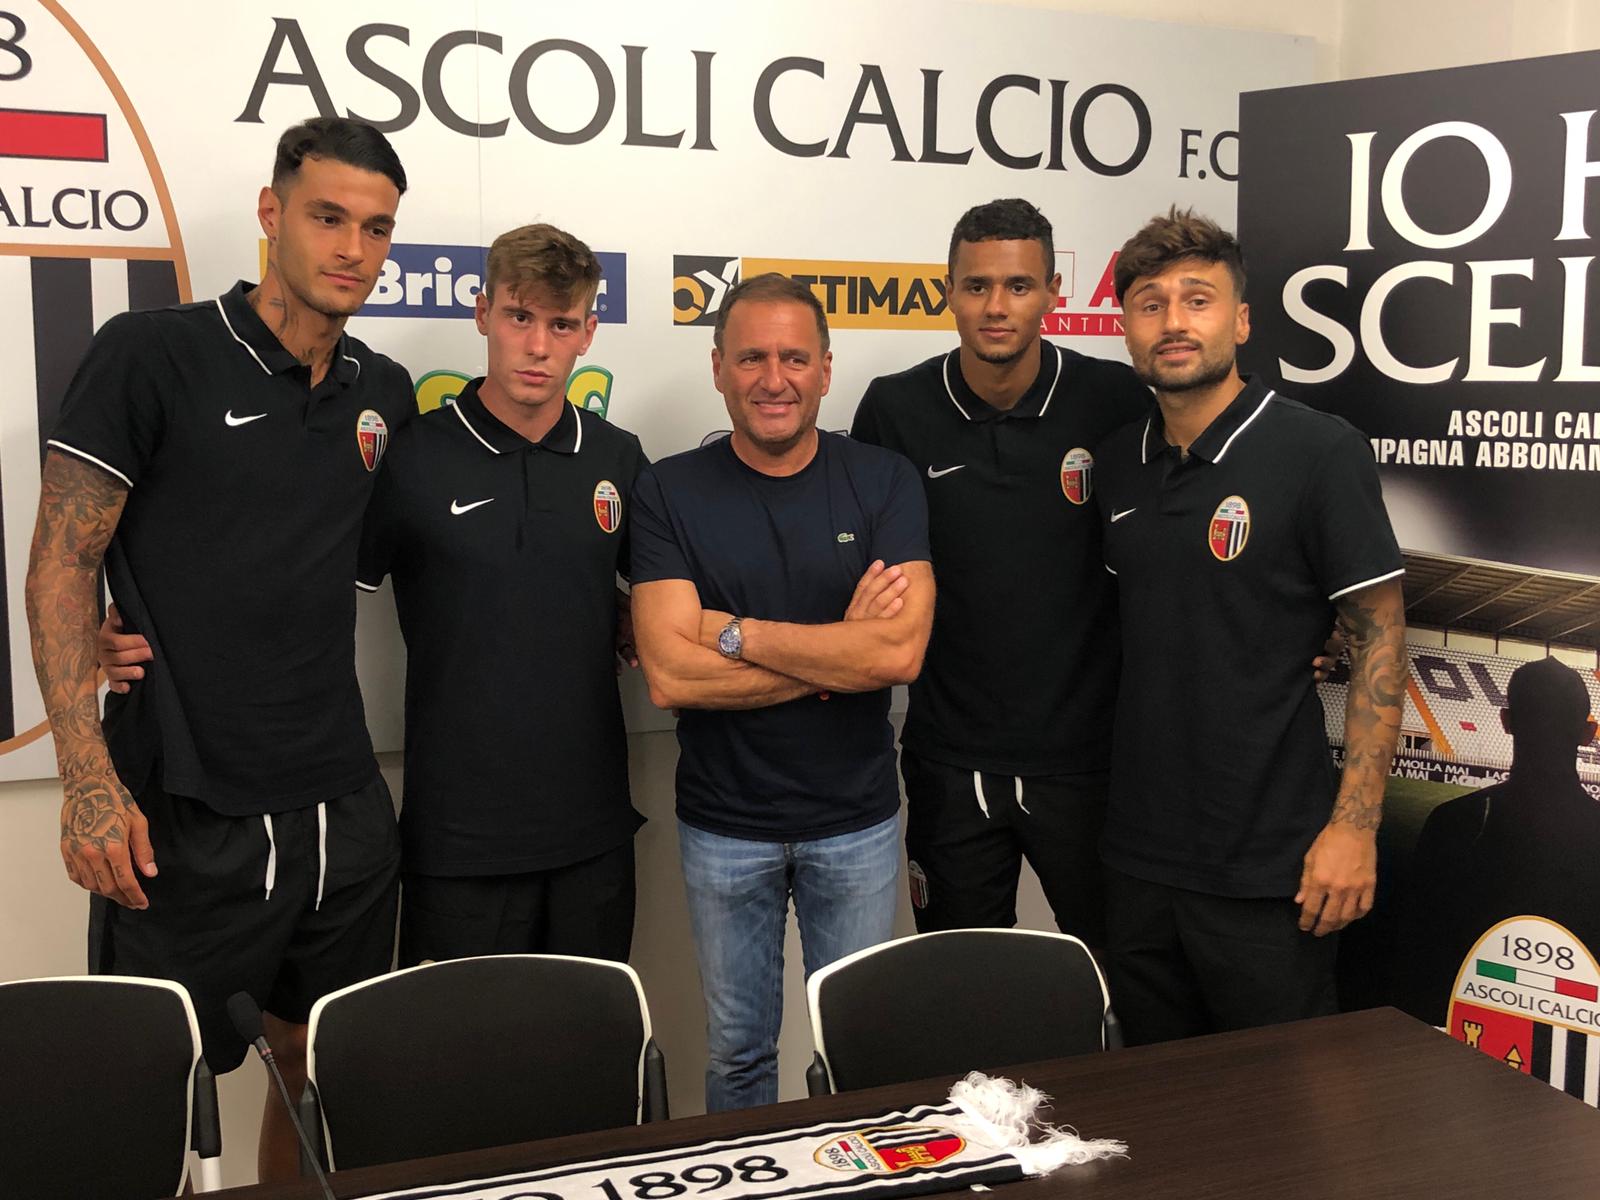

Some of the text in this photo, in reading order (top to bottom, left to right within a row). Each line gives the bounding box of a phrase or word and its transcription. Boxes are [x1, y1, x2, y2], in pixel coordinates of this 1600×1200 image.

[234, 17, 718, 150] ASCOLI
[753, 56, 1152, 177] CALCIO
[1343, 120, 1512, 251] IO
[1278, 256, 1600, 384] SCEL
[1448, 410, 1543, 438] ASCOLI
[1399, 759, 1442, 773] MOLLA
[1445, 765, 1469, 776] MAI
[1406, 769, 1429, 780] MAI
[1502, 934, 1574, 970] 1898
[1463, 982, 1534, 1011] ASCOLI
[592, 1155, 788, 1200] 1898
